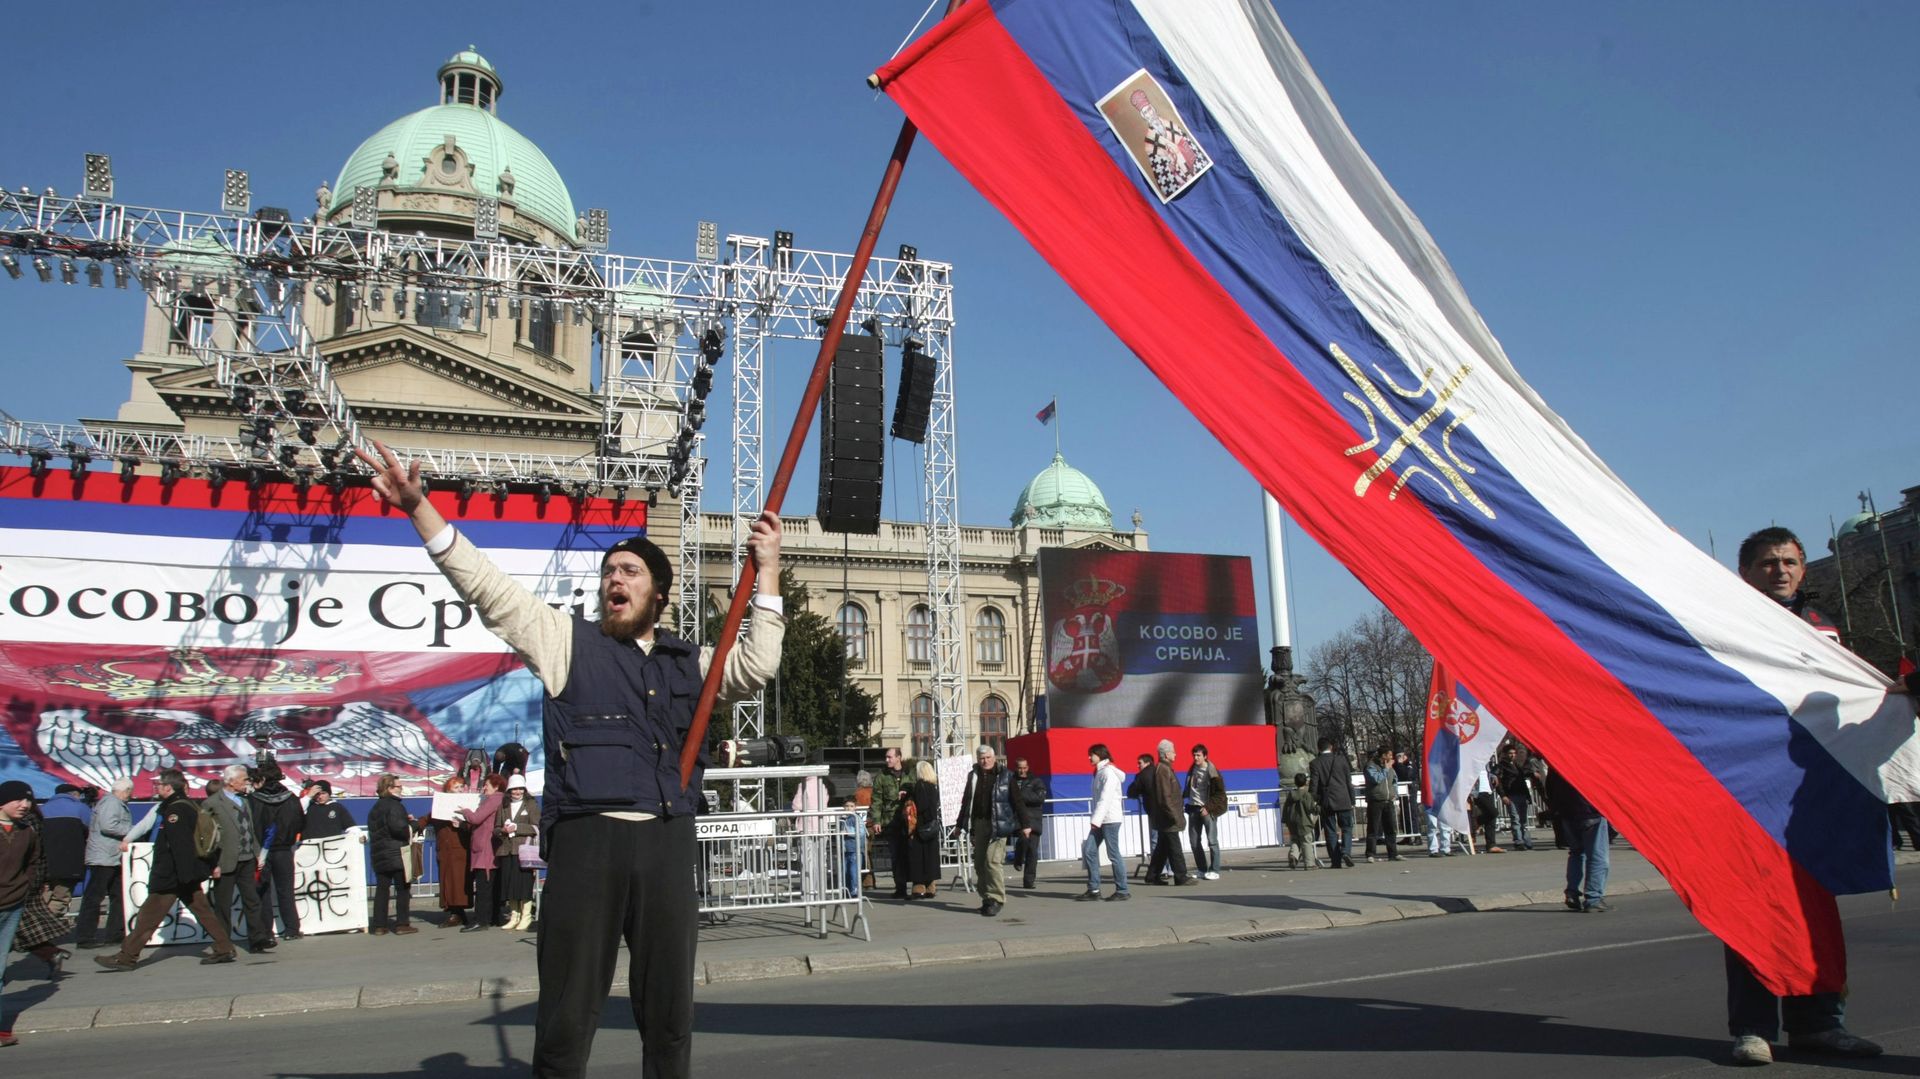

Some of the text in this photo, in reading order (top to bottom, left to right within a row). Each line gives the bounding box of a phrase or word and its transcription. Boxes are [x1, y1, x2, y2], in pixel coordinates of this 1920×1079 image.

[0, 565, 259, 625] осово
[275, 580, 344, 645] је
[1140, 625, 1244, 640] КОСОВО ЈЕ
[1155, 646, 1231, 661] СРБИЈА.
